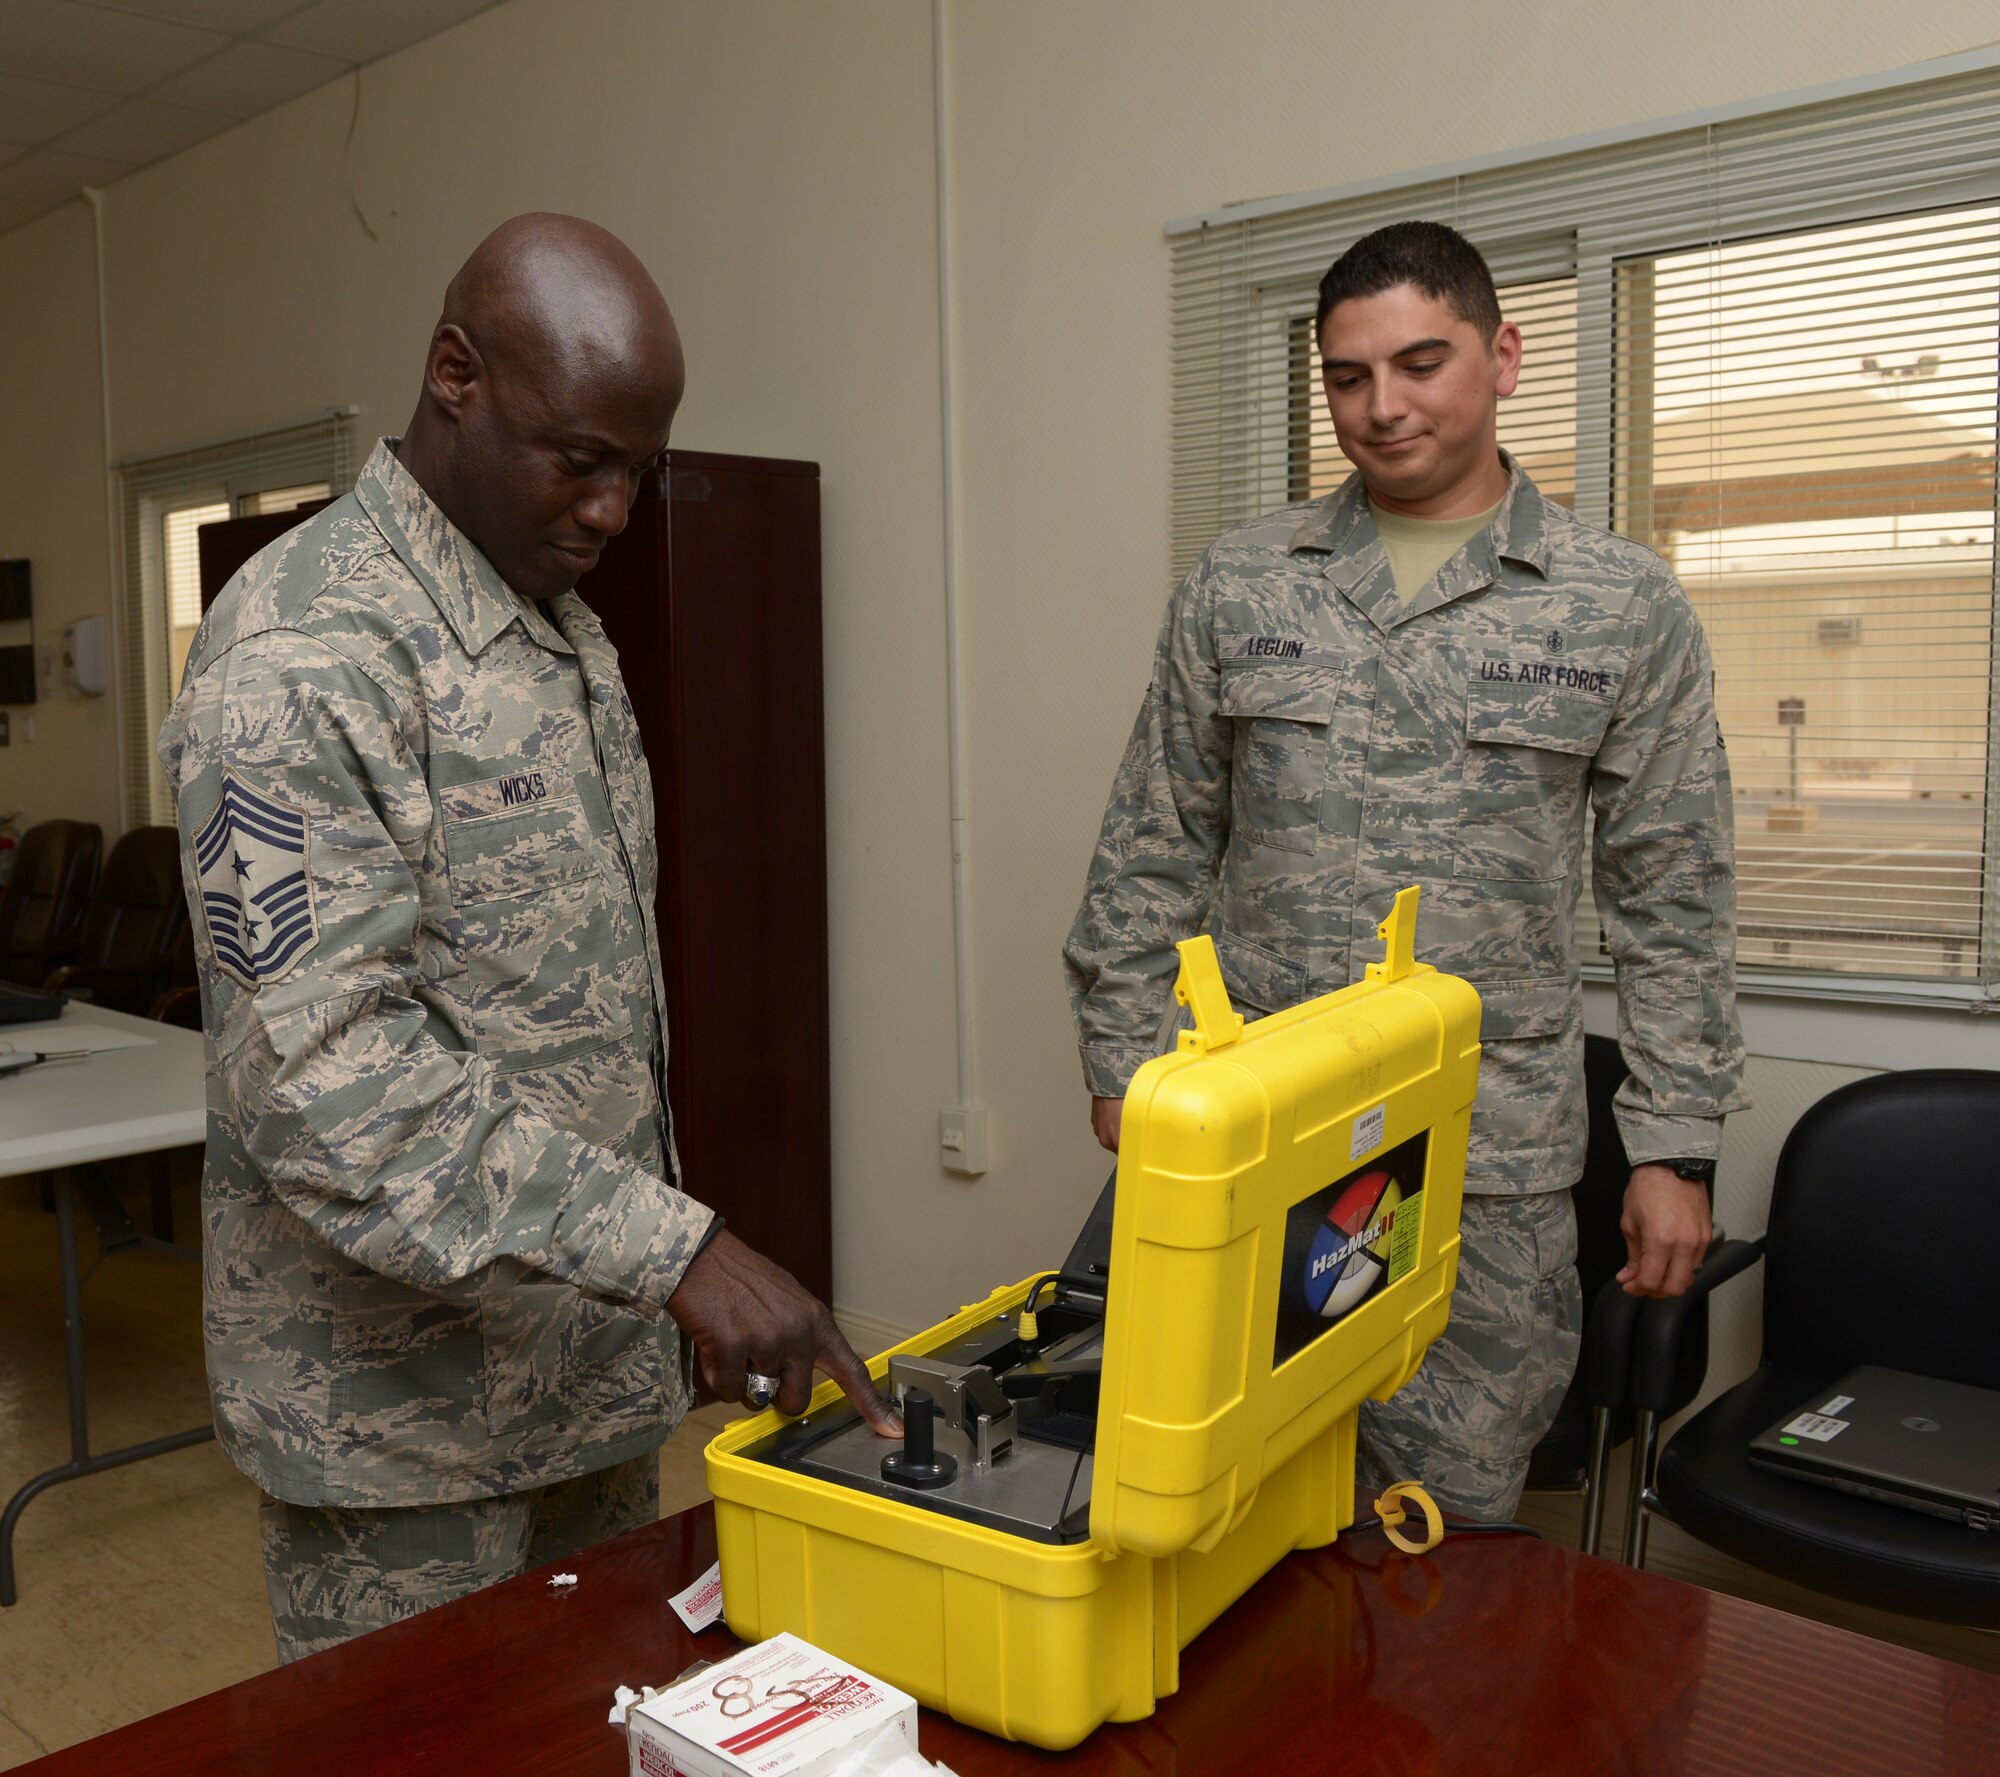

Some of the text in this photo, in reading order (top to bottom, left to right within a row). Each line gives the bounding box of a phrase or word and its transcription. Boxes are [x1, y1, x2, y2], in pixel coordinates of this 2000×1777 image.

[1247, 637, 1304, 659] LEGUIN
[1481, 661, 1611, 693] U.S. AIR FORCE
[499, 772, 547, 807] WICKS
[690, 1701, 710, 1712] 200
[812, 1685, 866, 1714] WEBCOL
[825, 1691, 876, 1720] KENDALL
[642, 1739, 675, 1765] KENDALL
